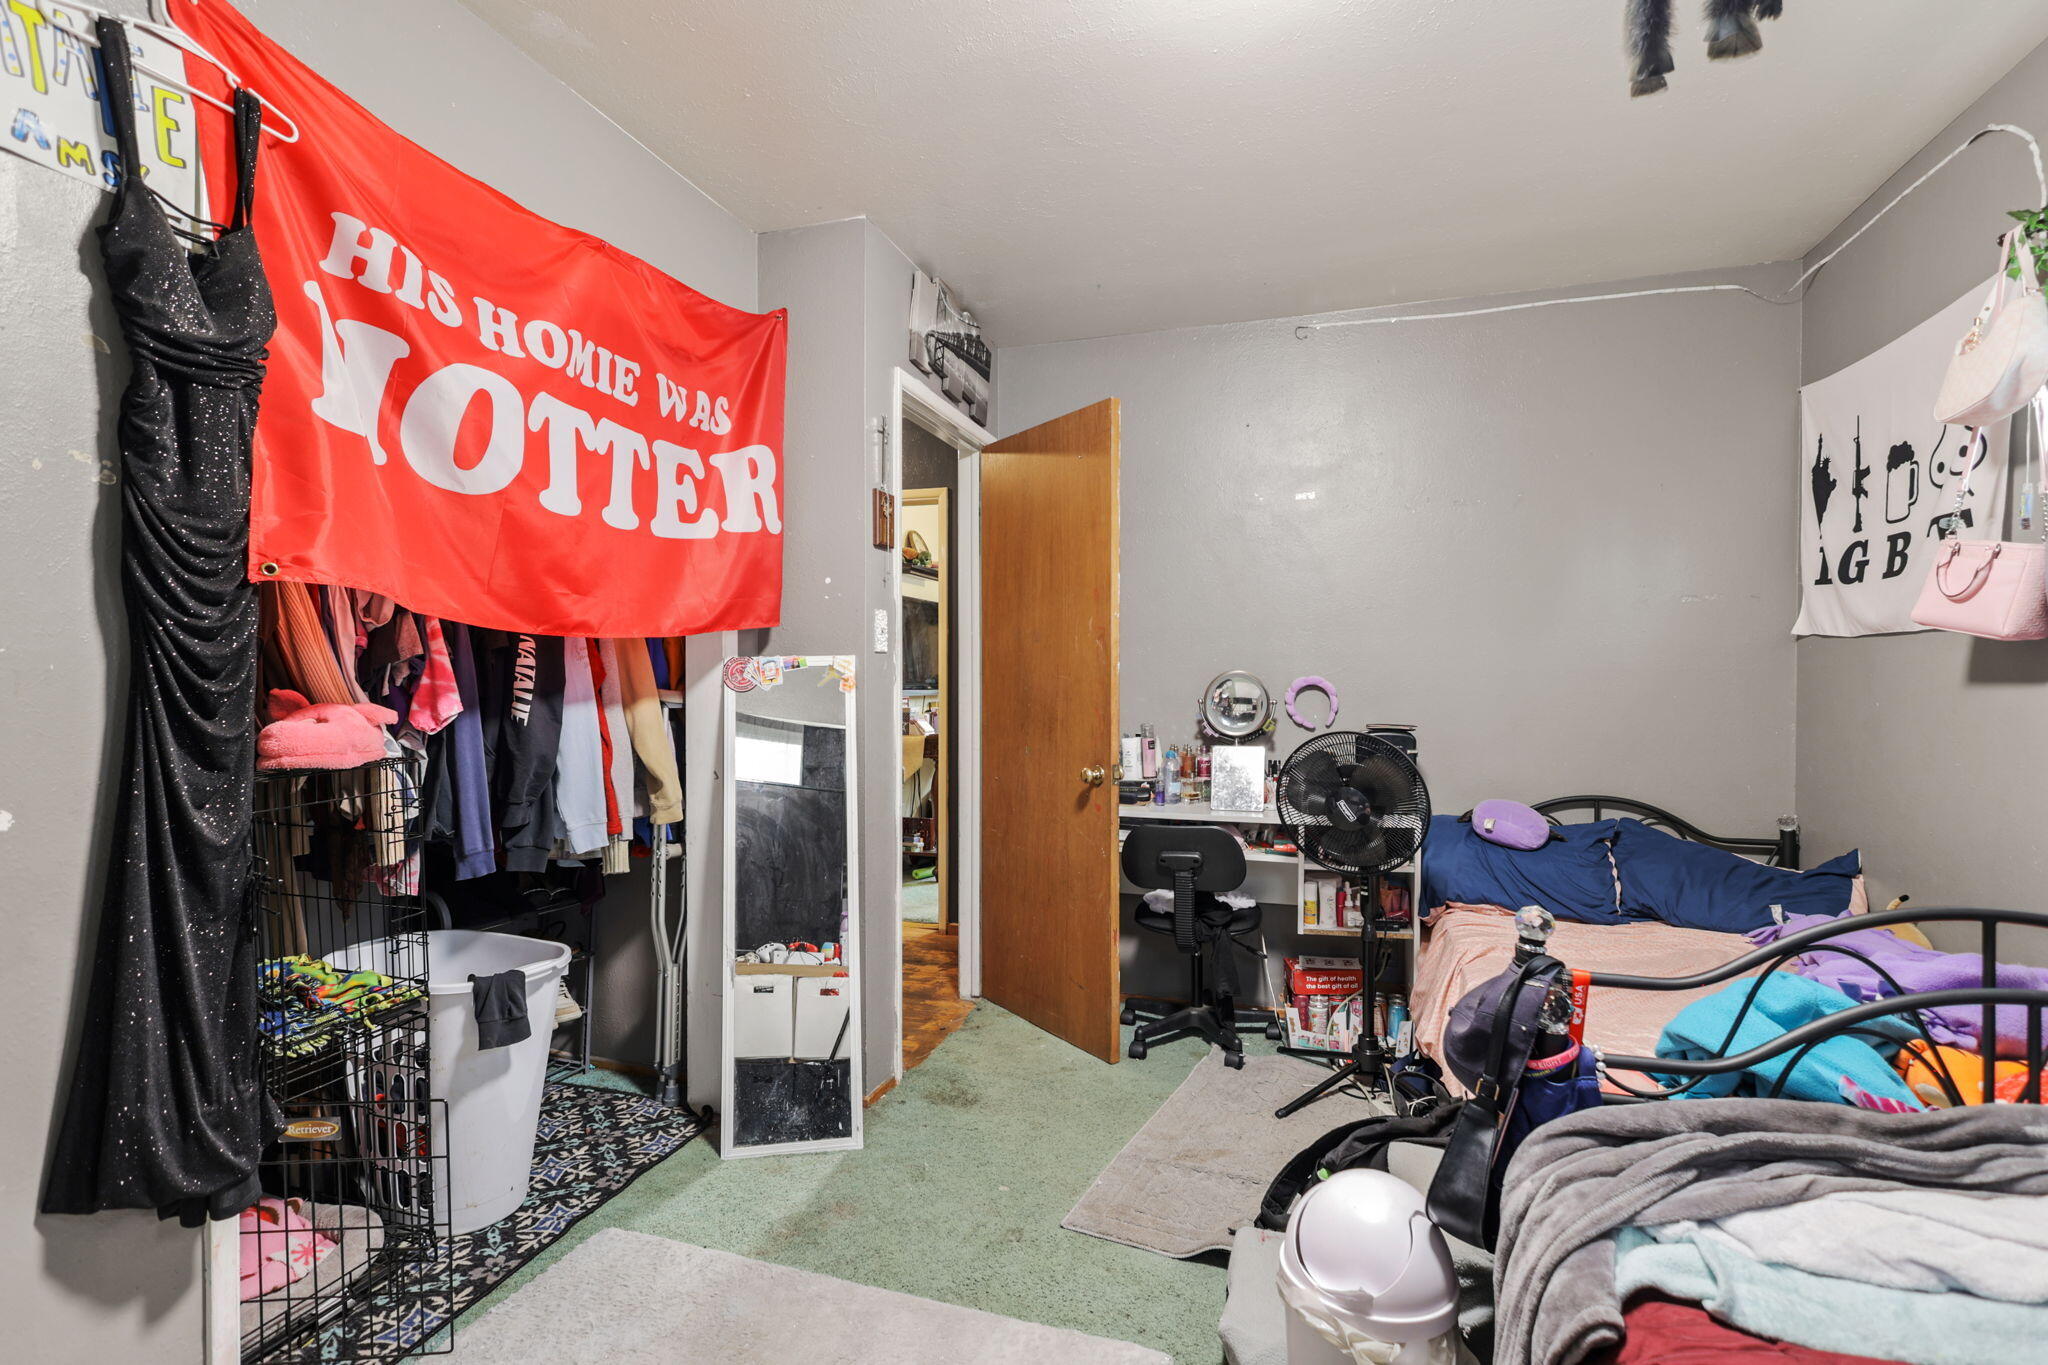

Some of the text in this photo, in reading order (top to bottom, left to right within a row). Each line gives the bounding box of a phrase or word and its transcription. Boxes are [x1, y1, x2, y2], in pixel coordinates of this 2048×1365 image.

[319, 212, 732, 435] HIS HOMIE WAS
[511, 635, 536, 727] NATALIE
[1574, 985, 1585, 1005] USA
[287, 1124, 334, 1135] Retriever
